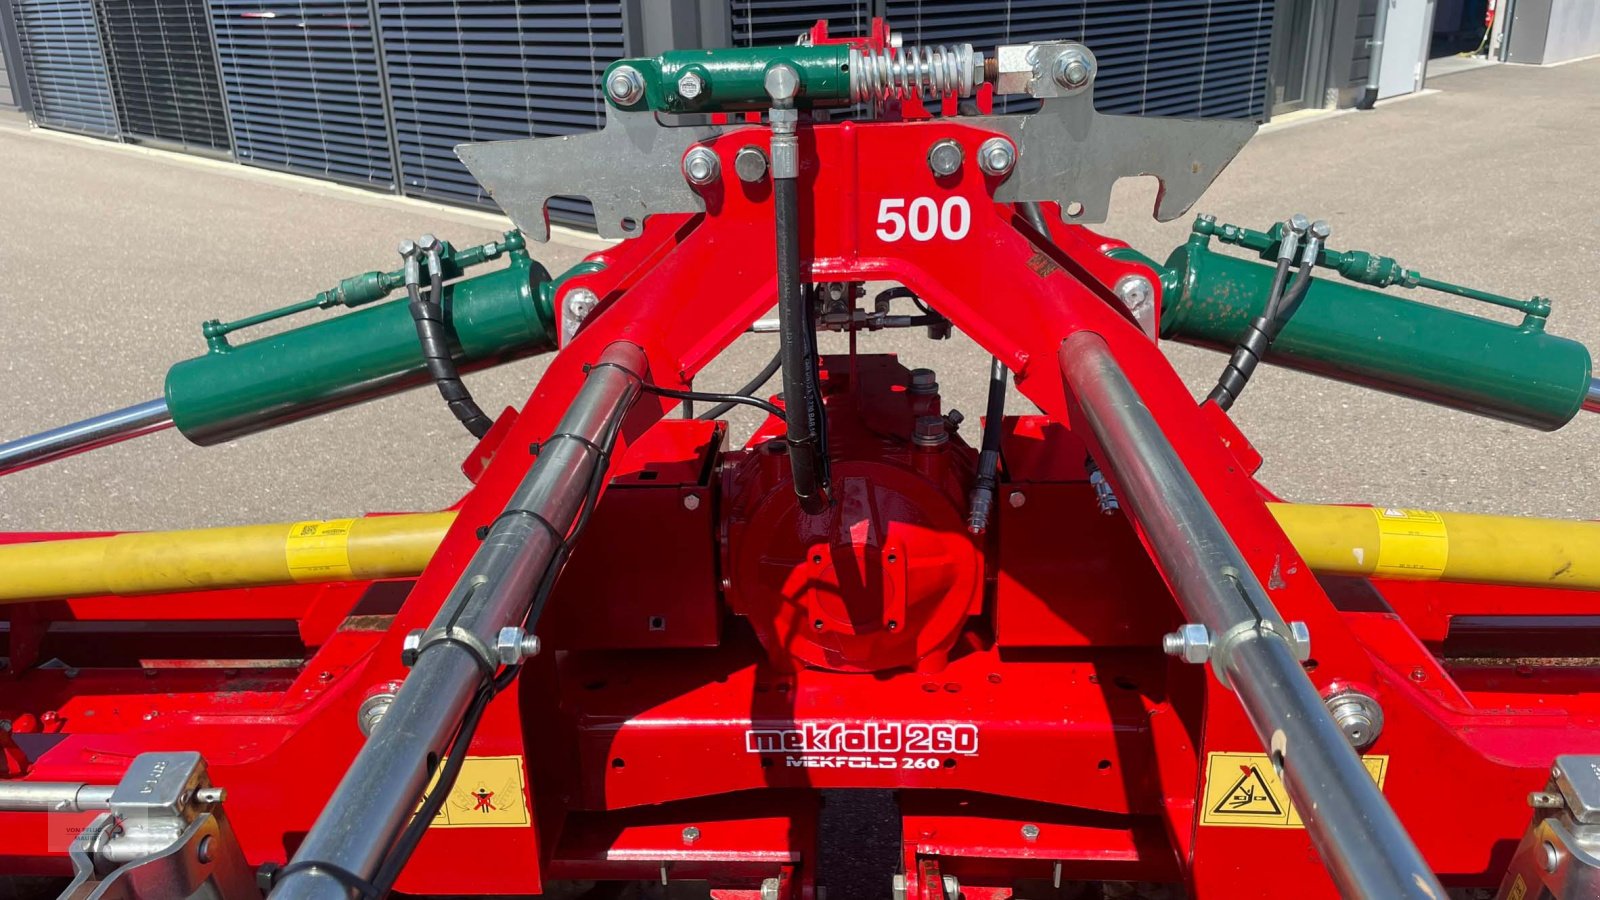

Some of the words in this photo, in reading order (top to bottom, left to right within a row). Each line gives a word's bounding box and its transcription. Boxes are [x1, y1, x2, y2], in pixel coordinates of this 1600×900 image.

[875, 195, 971, 242] 500
[745, 722, 902, 753] mekfold
[905, 723, 979, 754] 260
[786, 755, 898, 769] MEKFOLD
[902, 757, 940, 769] 260
